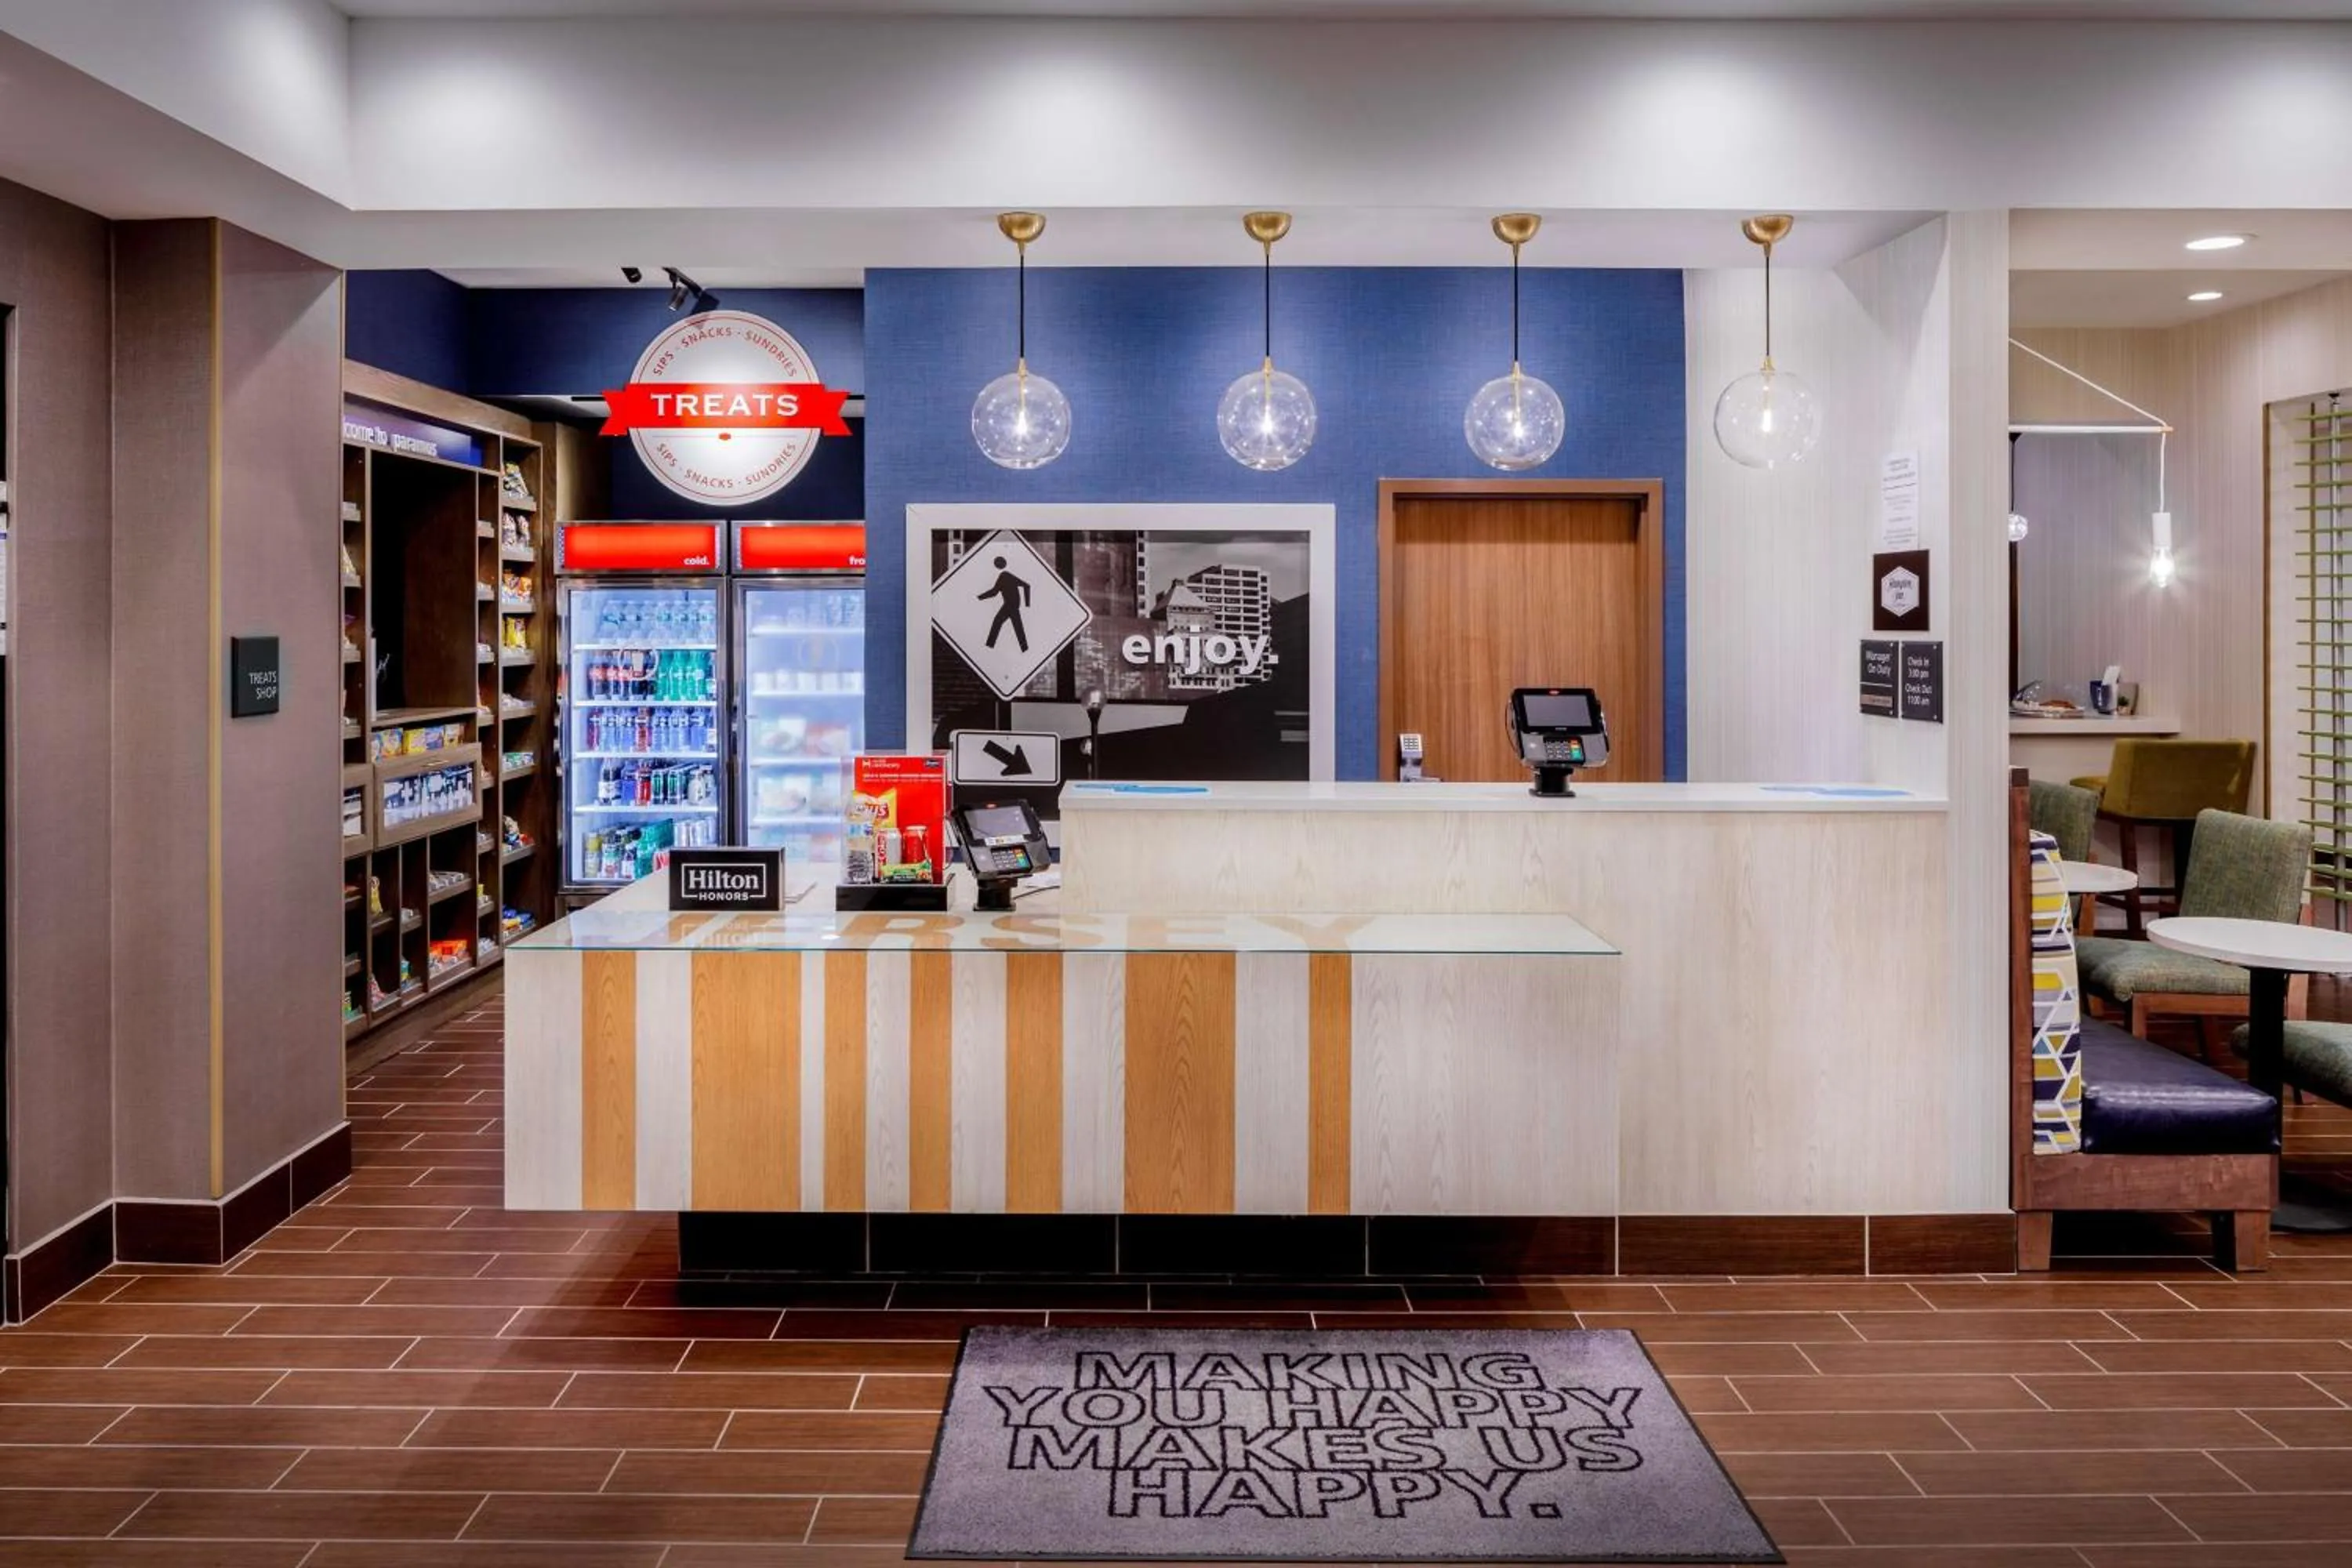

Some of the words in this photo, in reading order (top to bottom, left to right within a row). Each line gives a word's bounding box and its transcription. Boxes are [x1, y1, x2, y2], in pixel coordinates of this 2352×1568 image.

[653, 350, 674, 376] SIPS
[681, 327, 732, 347] SNACKS
[746, 330, 797, 377] SUNDRIES
[650, 394, 799, 416] TREATS
[657, 444, 677, 467] SIPS
[684, 470, 733, 488] SNACKS
[746, 443, 797, 485] SUNDRIES
[849, 555, 866, 565] fro
[1122, 625, 1279, 674] enjoy.
[1907, 657, 1923, 666] Check
[249, 671, 277, 684] TREATS
[1905, 684, 1921, 692] Check
[688, 869, 759, 889] Hilton
[699, 892, 749, 901] HONORS
[1075, 1352, 1545, 1390] MAKING
[982, 1386, 1226, 1428] YOU
[1265, 1387, 1642, 1429] HAPPY
[1007, 1425, 1447, 1472] MAKES
[1478, 1425, 1643, 1472] US
[1108, 1468, 1563, 1519] HAPPY.
